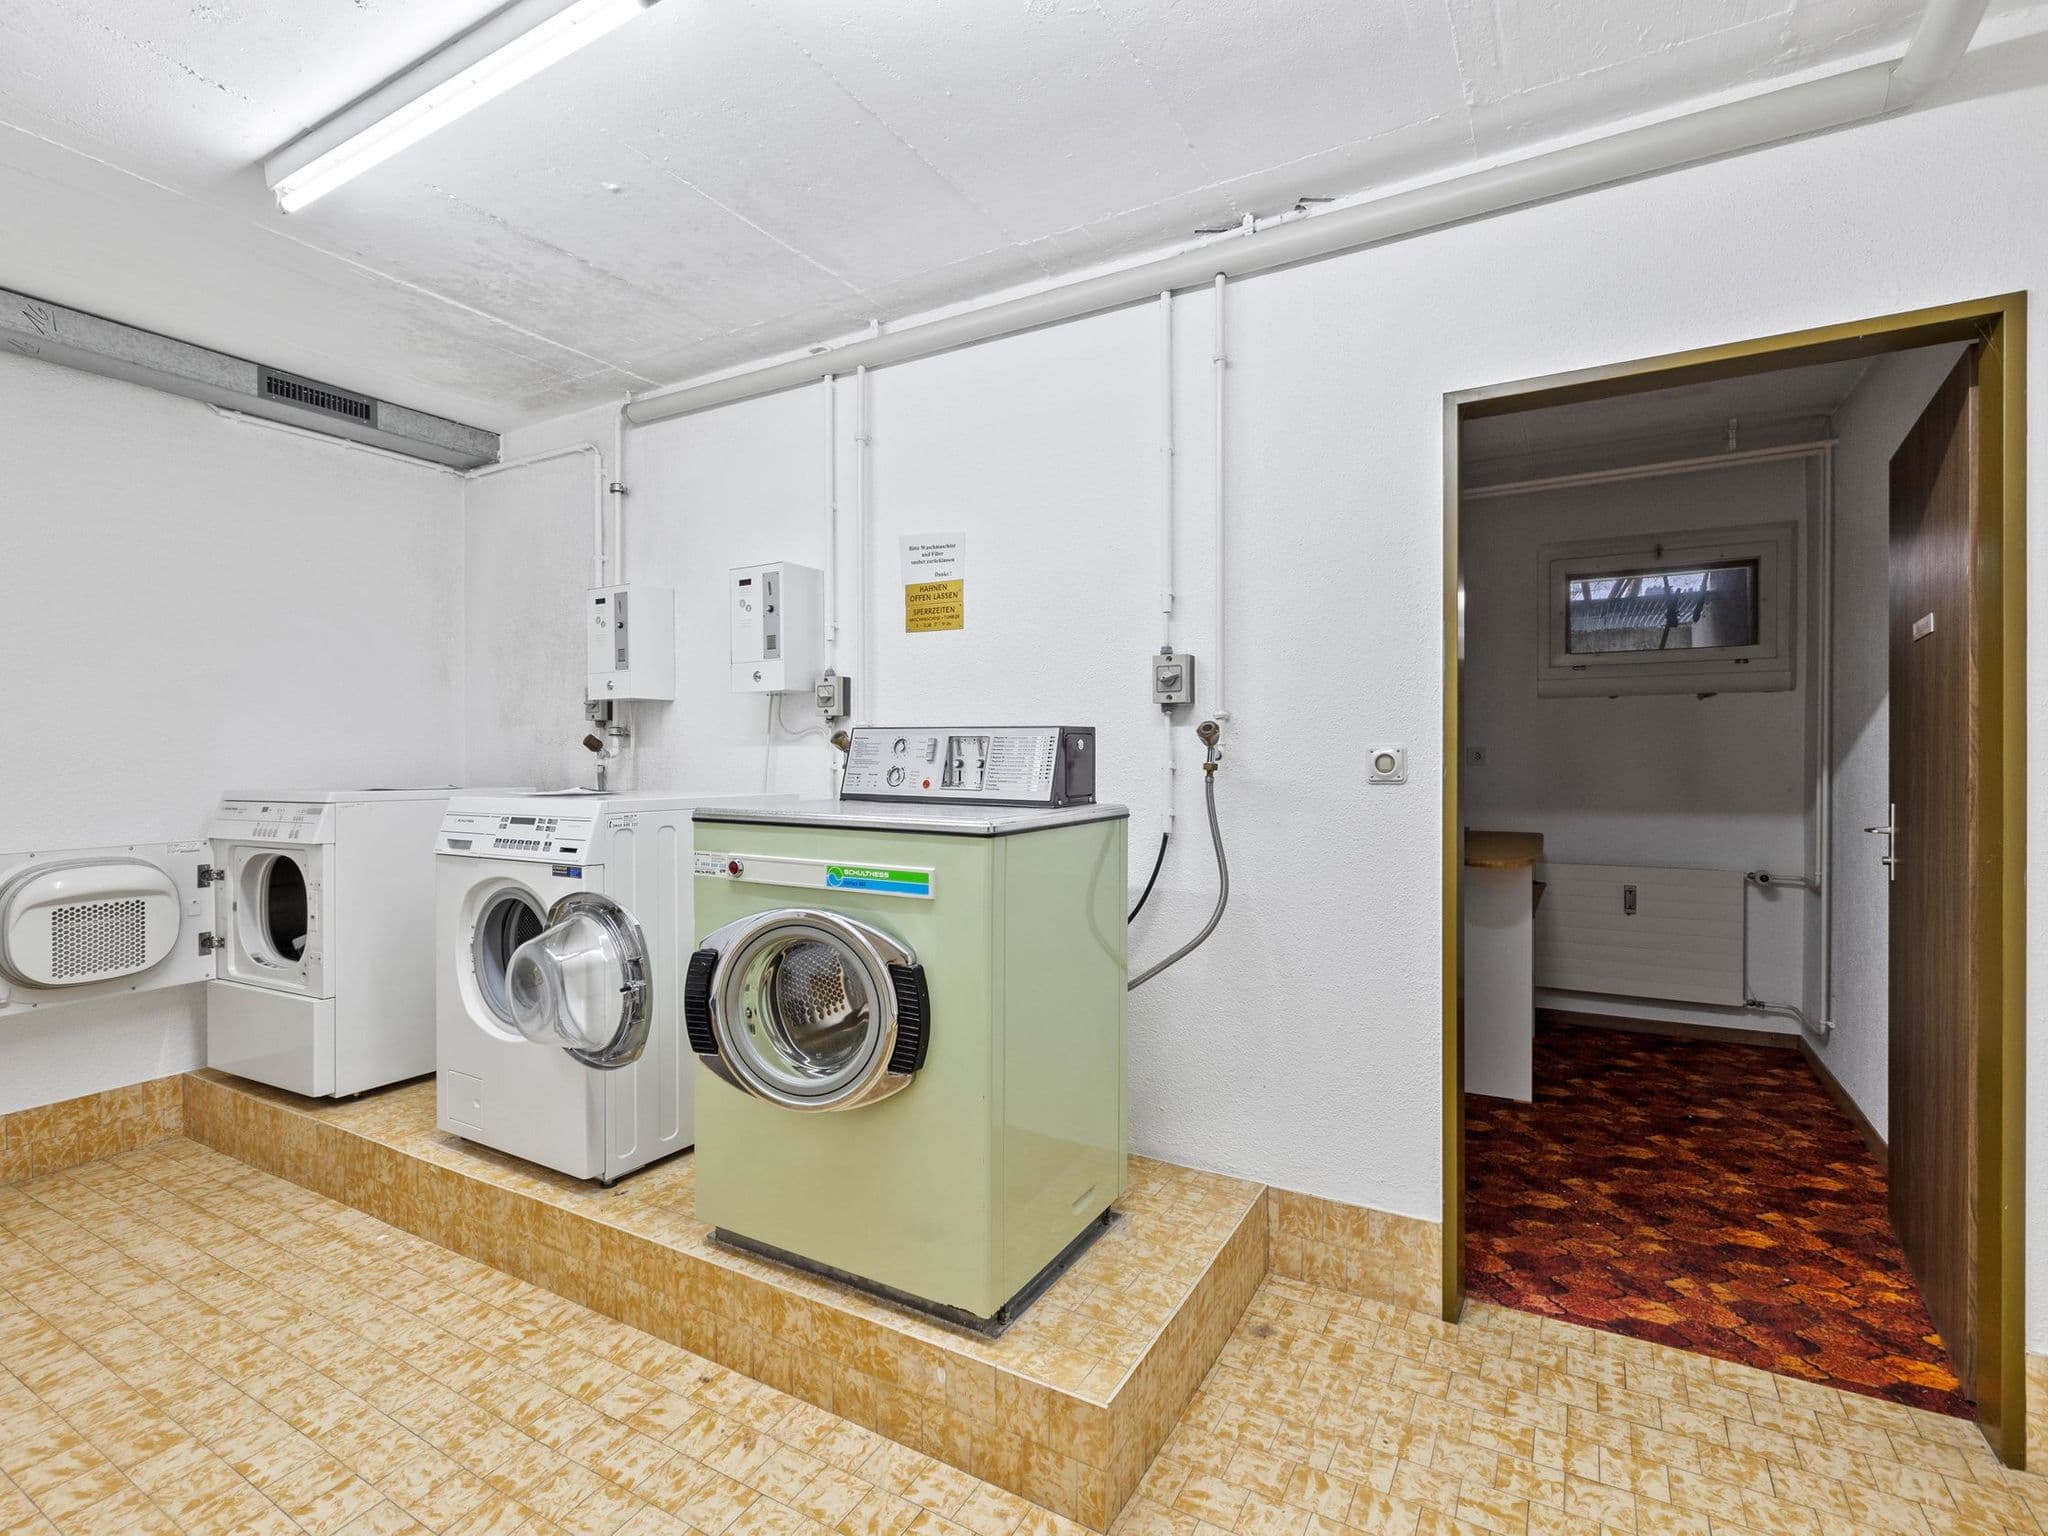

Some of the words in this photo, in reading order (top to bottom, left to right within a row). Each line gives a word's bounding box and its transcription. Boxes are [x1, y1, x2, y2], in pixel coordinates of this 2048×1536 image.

[919, 583, 948, 592] HAHNEN
[909, 594, 931, 602] OFFEN
[933, 591, 958, 600] LASSEN
[913, 606, 955, 616] SPERRZEITEN
[843, 869, 889, 878] SCHULTHESS
